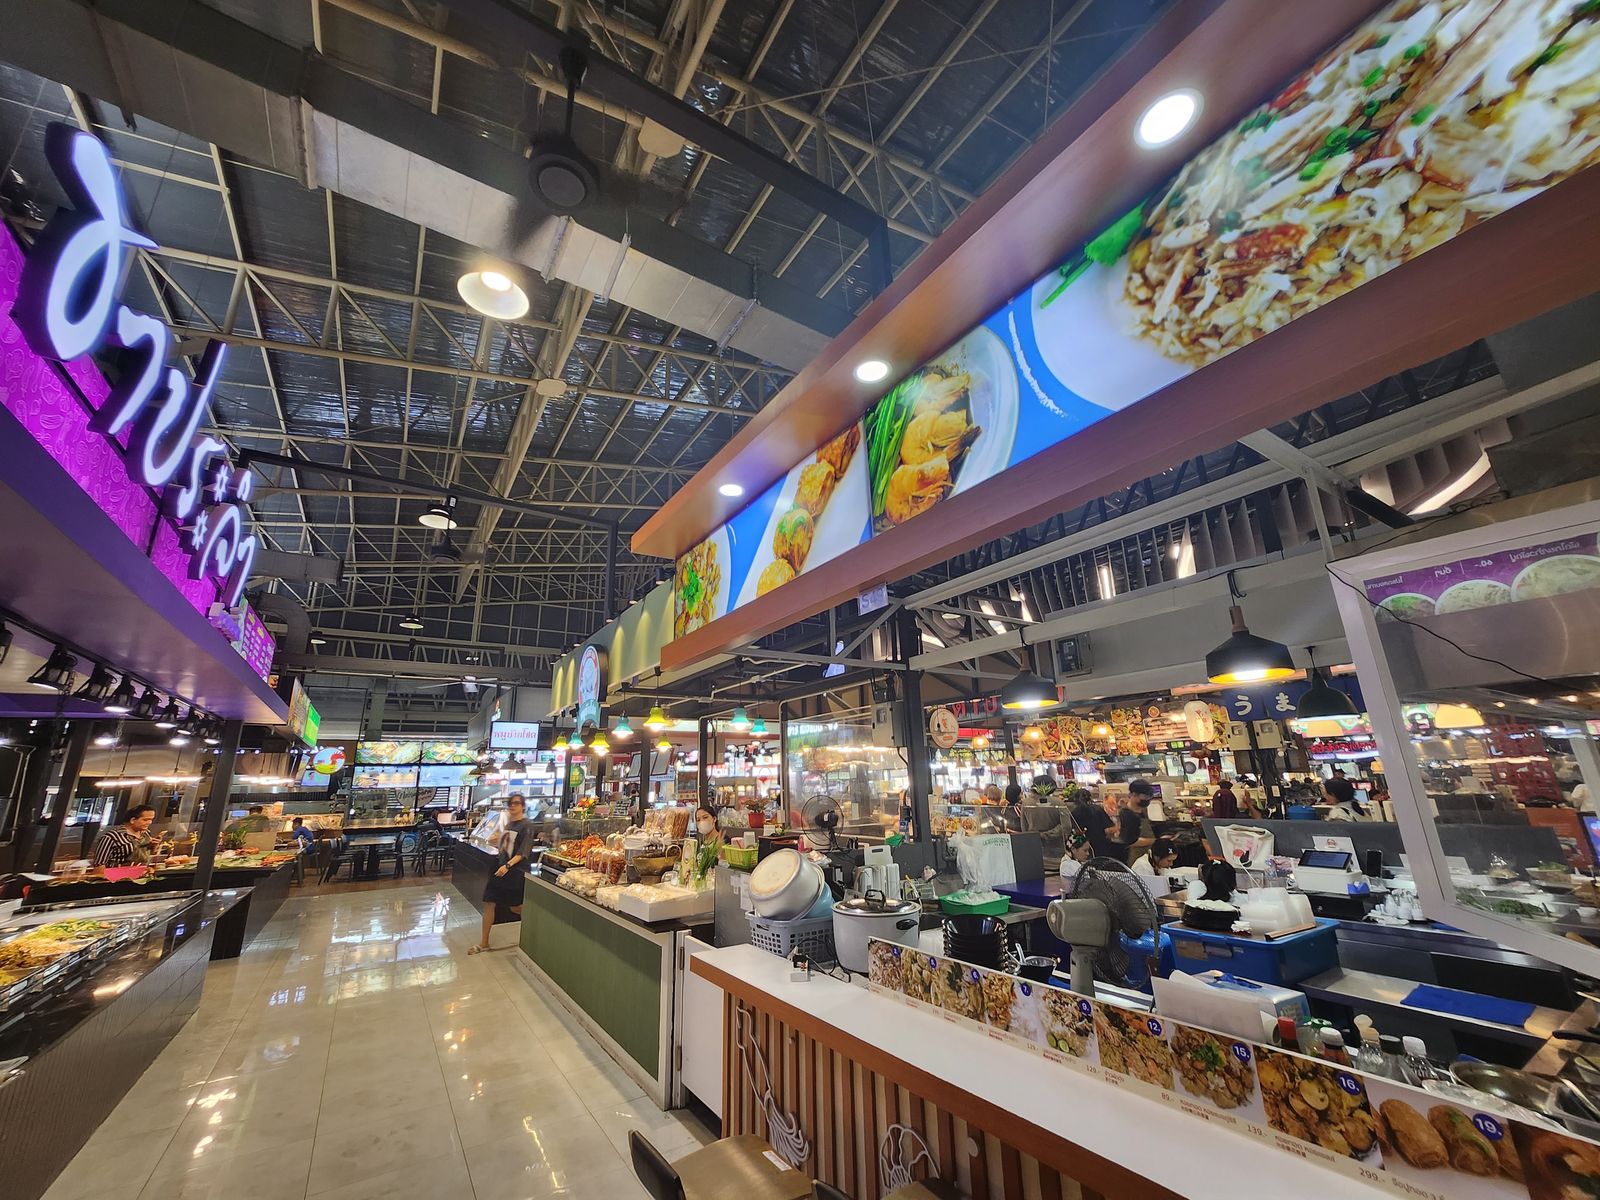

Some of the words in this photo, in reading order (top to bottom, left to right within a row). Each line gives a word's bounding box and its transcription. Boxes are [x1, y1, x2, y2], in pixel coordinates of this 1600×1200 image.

[1234, 1046, 1250, 1058] 15.
[1339, 1076, 1360, 1092] 16.
[1475, 1118, 1502, 1136] 19.
